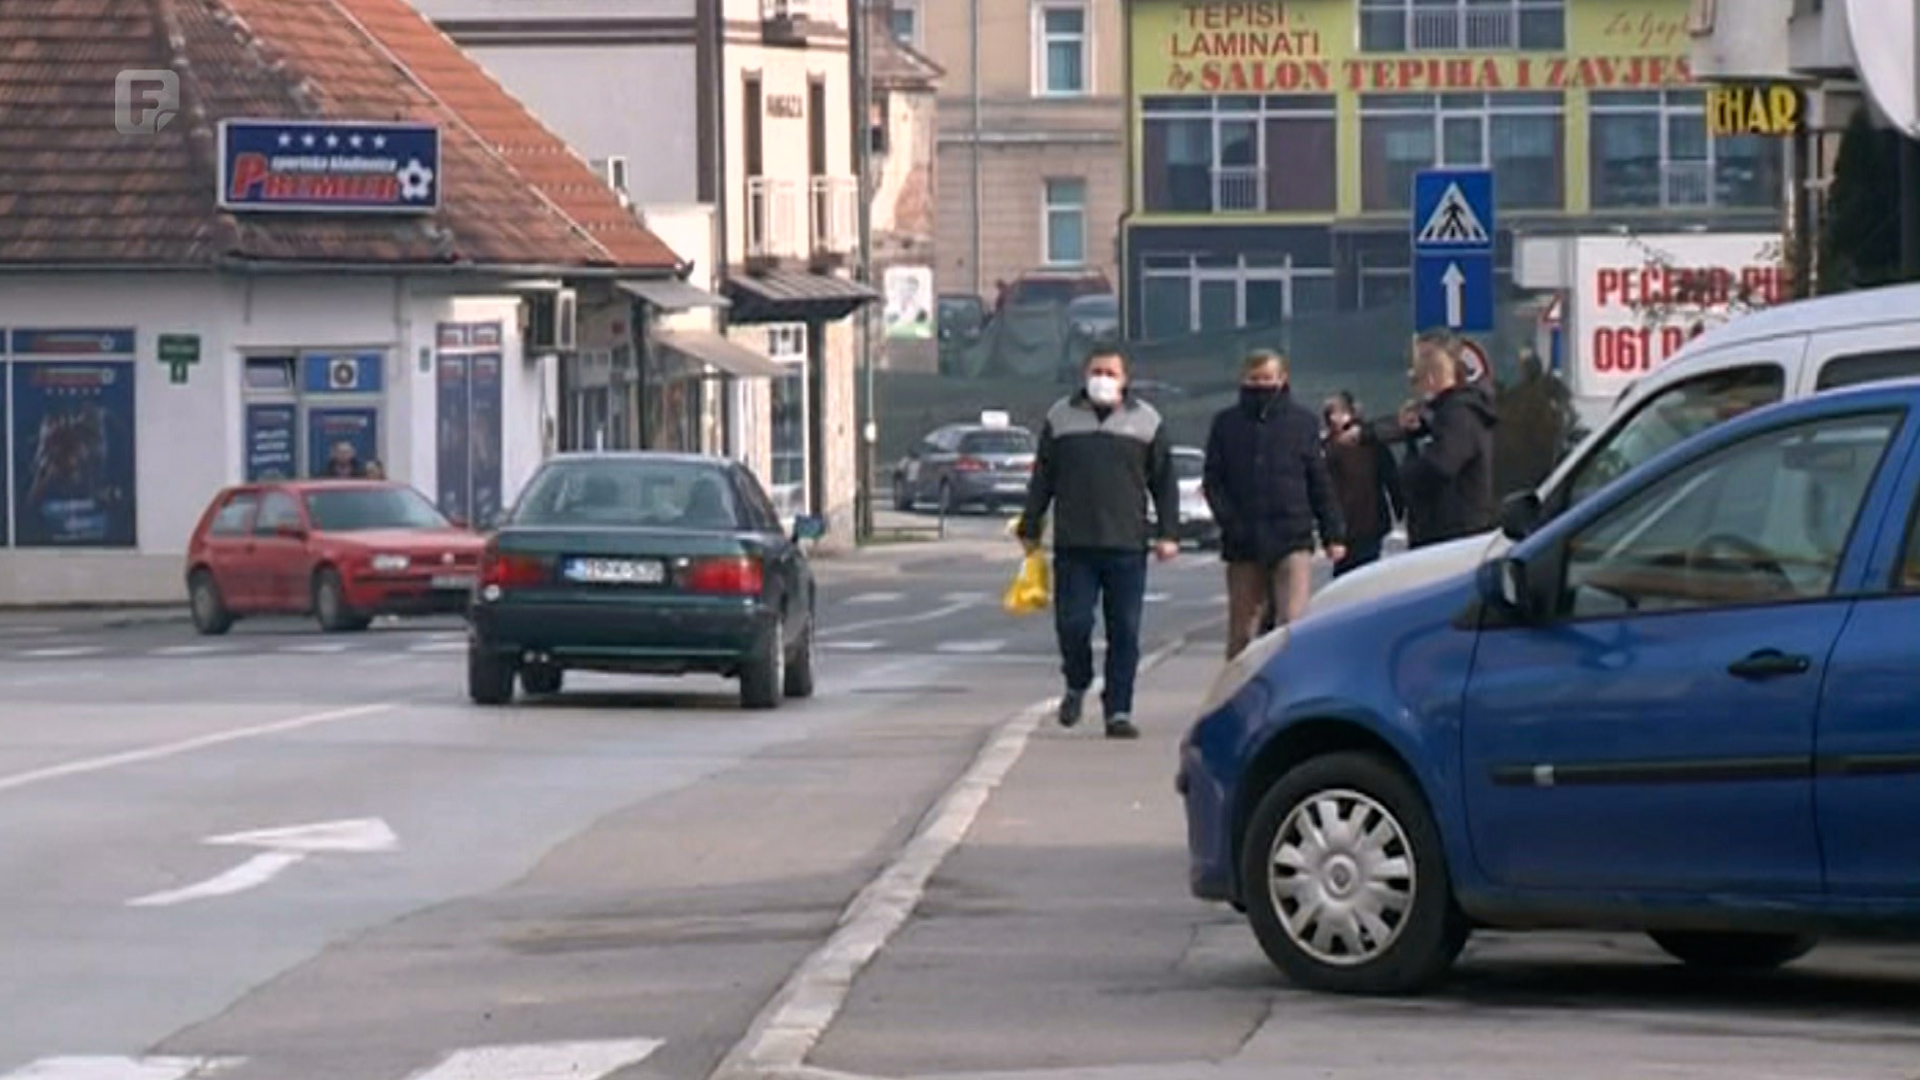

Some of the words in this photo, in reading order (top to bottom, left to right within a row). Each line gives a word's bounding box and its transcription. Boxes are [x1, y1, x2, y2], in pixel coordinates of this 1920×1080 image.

[1182, 3, 1285, 30] TEPISI
[1171, 33, 1320, 60] LAMINATI
[1200, 61, 1331, 91] SALON
[1343, 58, 1501, 88] TEPIHA
[1517, 58, 1530, 88] I
[1594, 326, 1650, 373] 061
